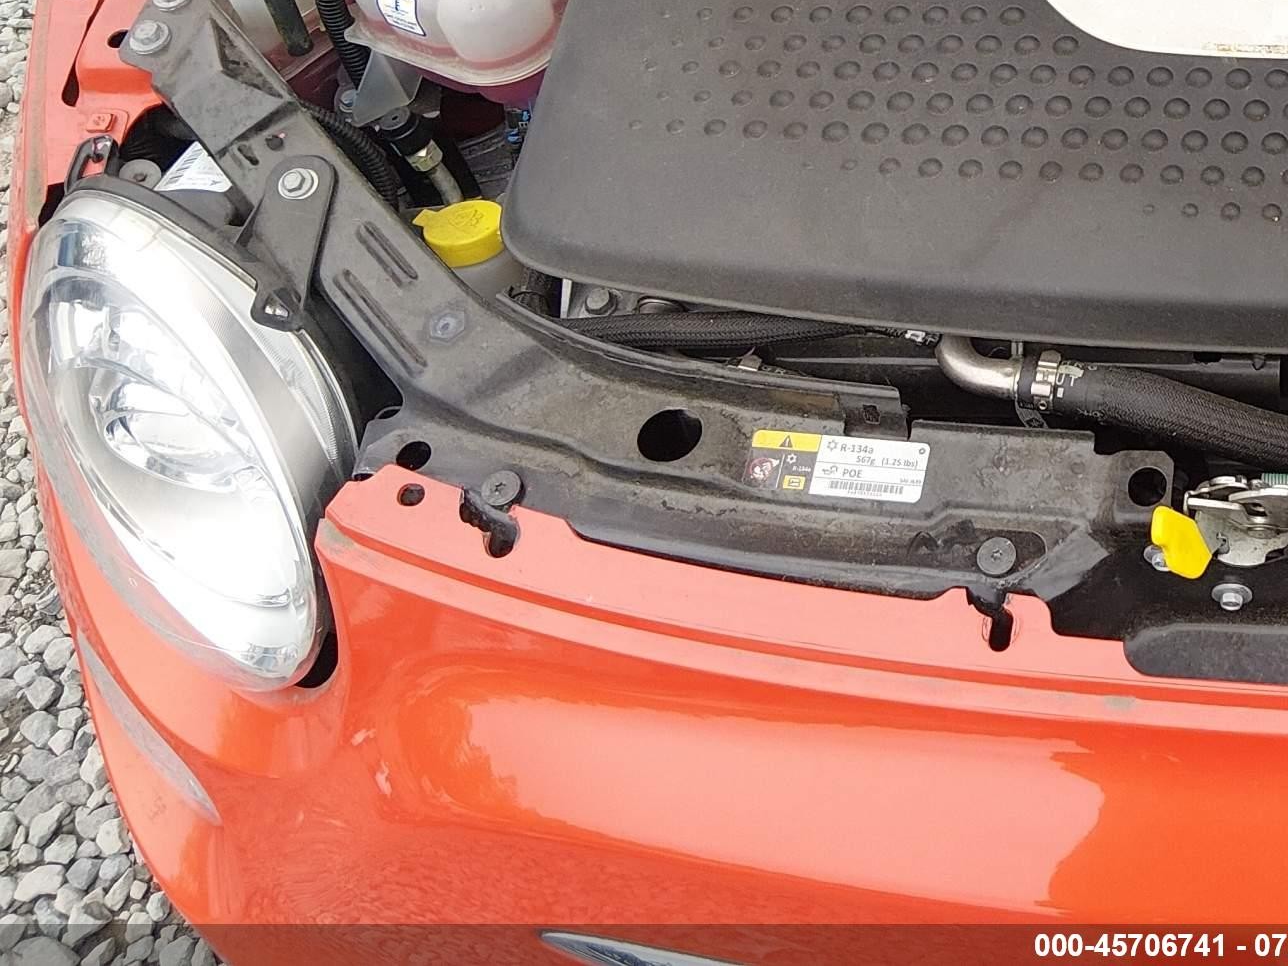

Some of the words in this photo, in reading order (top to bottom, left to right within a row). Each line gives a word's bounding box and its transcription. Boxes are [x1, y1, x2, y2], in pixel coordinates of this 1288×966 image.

[840, 443, 874, 454] R-134a
[855, 455, 876, 466] 567g
[842, 468, 863, 478] POE
